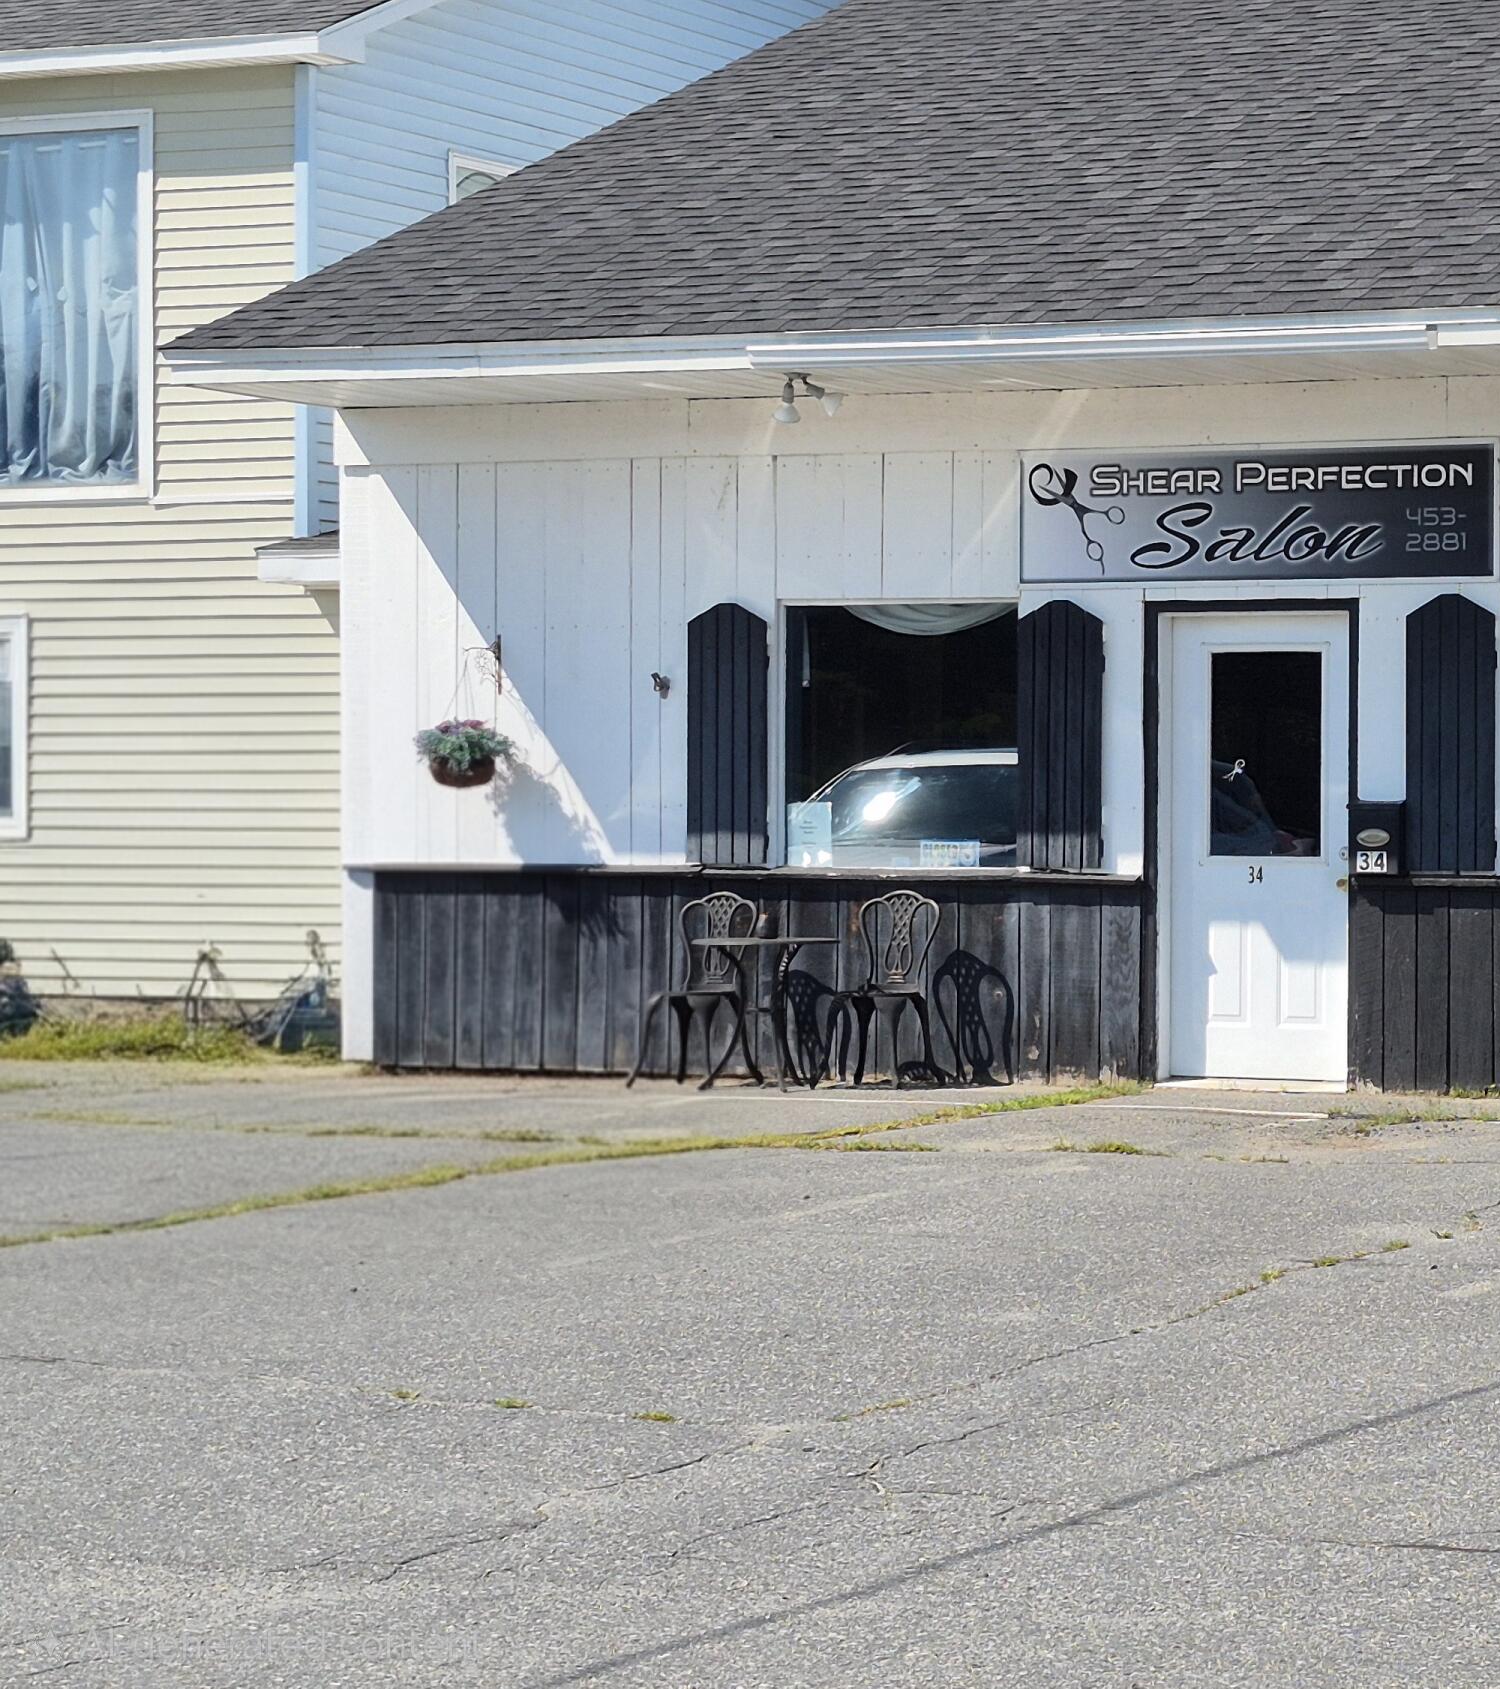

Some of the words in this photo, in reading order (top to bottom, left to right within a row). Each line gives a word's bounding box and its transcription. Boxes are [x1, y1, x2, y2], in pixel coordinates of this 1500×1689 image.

[1091, 465, 1222, 495] SHEAR
[1236, 462, 1473, 492] PERFECTION
[1406, 507, 1467, 526] 453-
[1130, 502, 1383, 569] Salon
[1406, 532, 1467, 551] 2881
[1358, 852, 1386, 871] 34
[1248, 865, 1263, 883] 34
